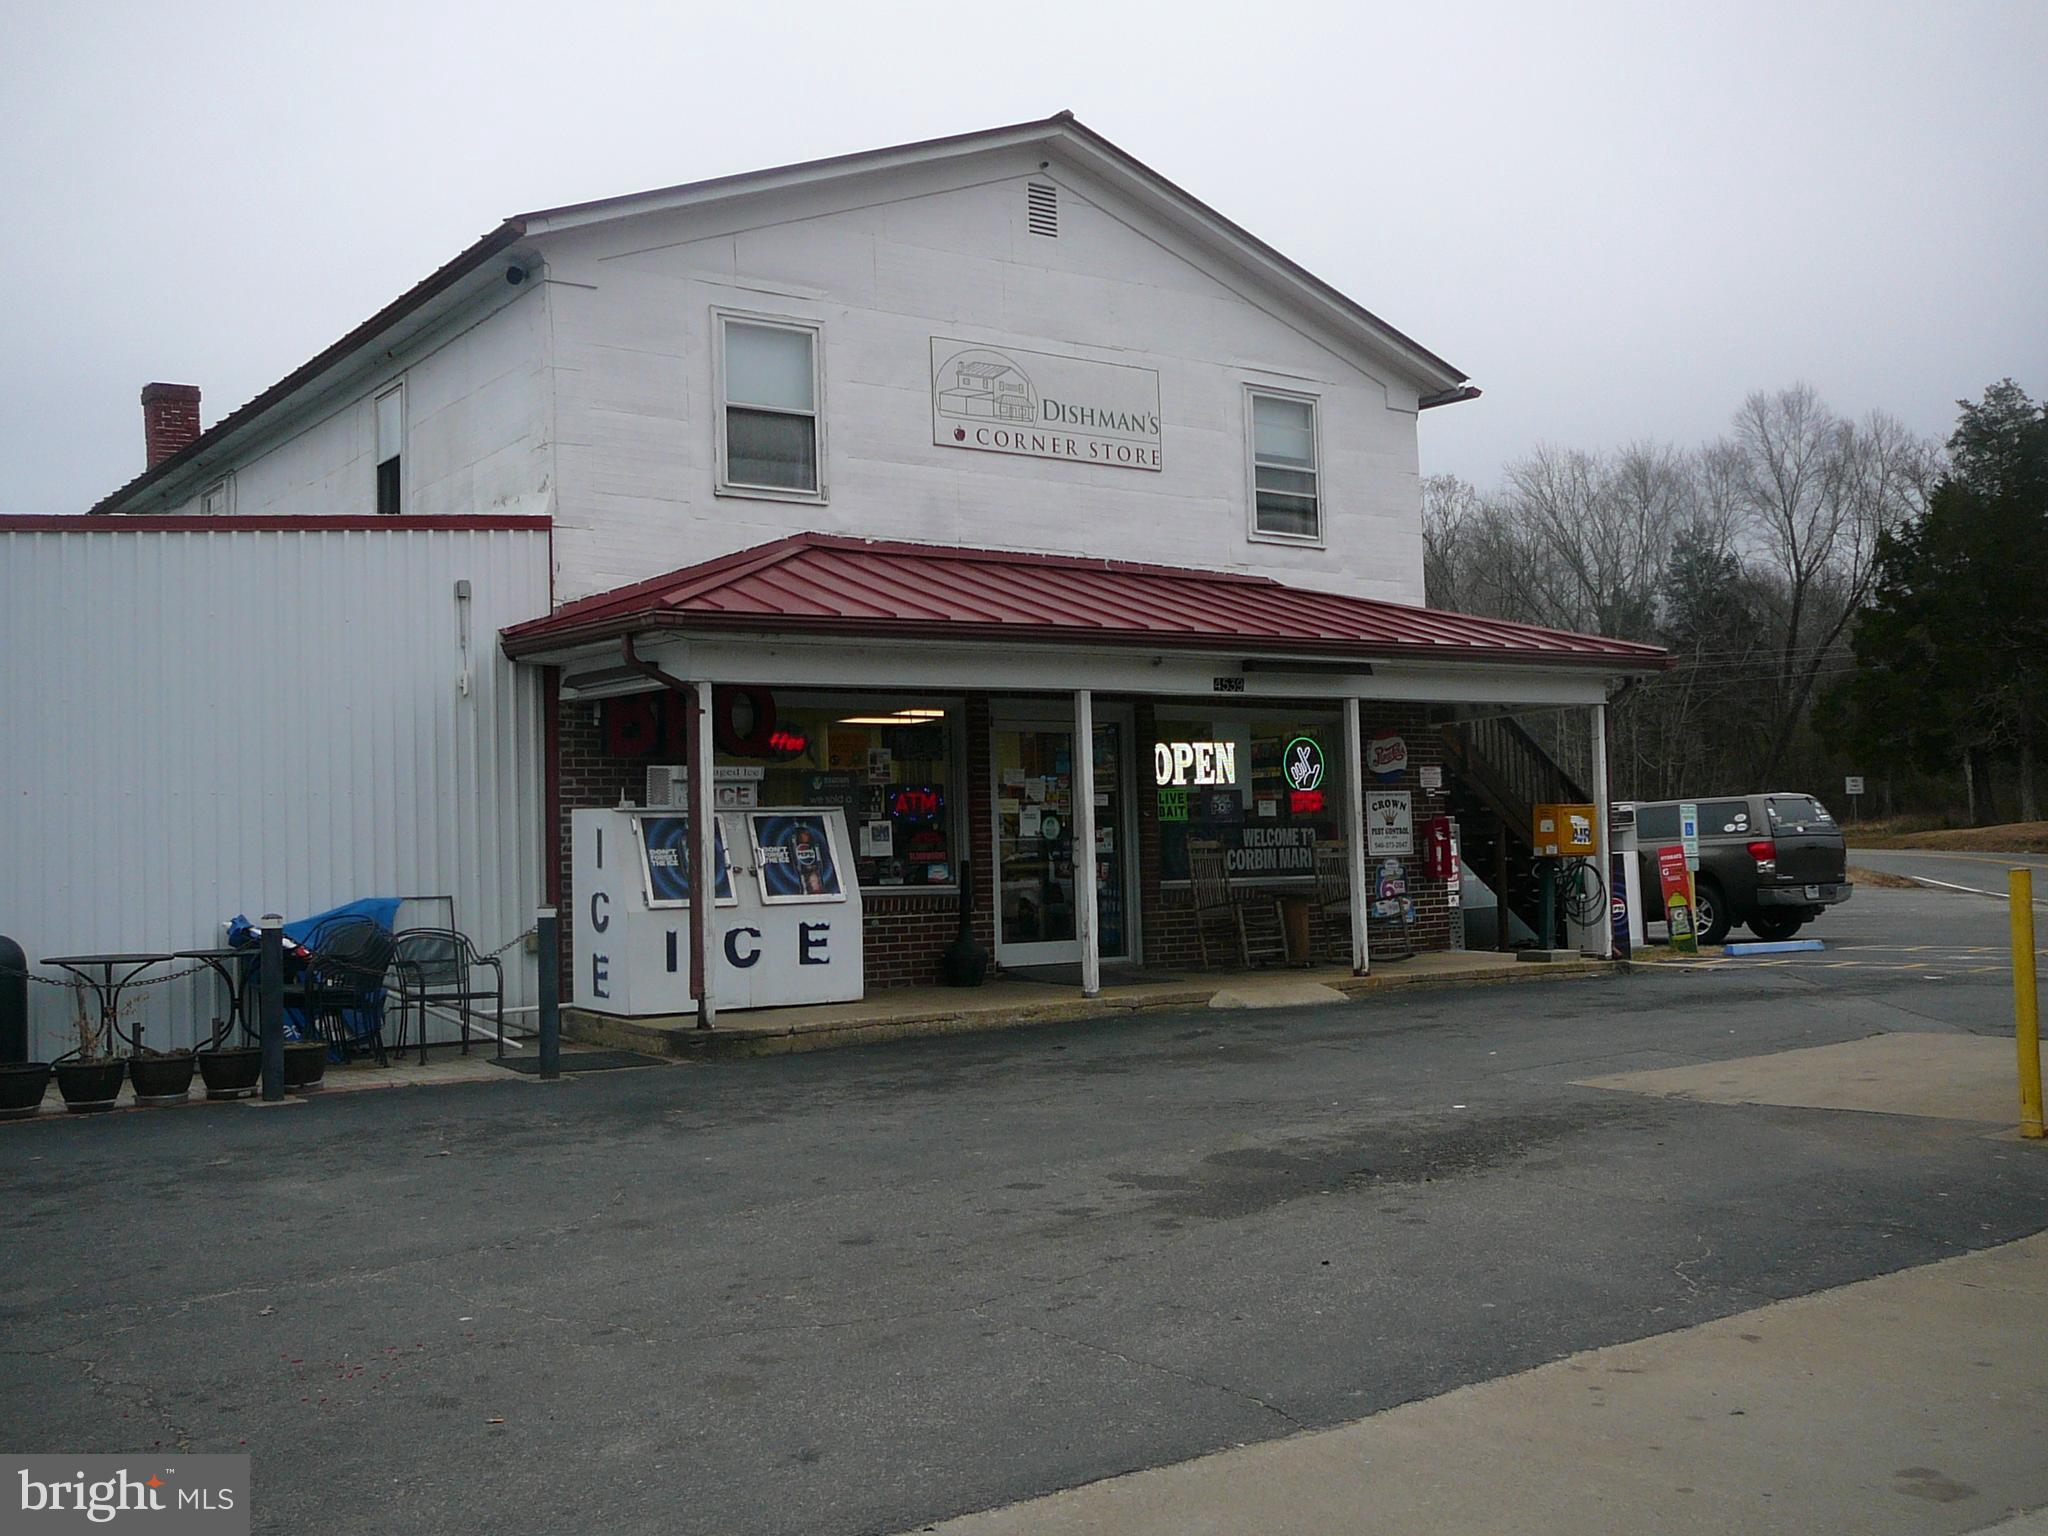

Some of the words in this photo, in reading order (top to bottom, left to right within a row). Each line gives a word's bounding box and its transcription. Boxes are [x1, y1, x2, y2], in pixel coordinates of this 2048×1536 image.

[1043, 398, 1159, 435] DISHMAN'S
[976, 428, 1079, 456] CORNER
[1089, 441, 1160, 466] STORE
[1214, 678, 1244, 692] 4539
[1155, 742, 1236, 786] OPEN
[896, 792, 938, 816] ATM
[1158, 793, 1184, 805] LIVE
[1372, 799, 1407, 811] CROWN
[1158, 806, 1185, 818] BAIT
[1242, 827, 1299, 847] WELCOME
[1227, 847, 1277, 870] CORBIN
[666, 920, 830, 972] ICE
